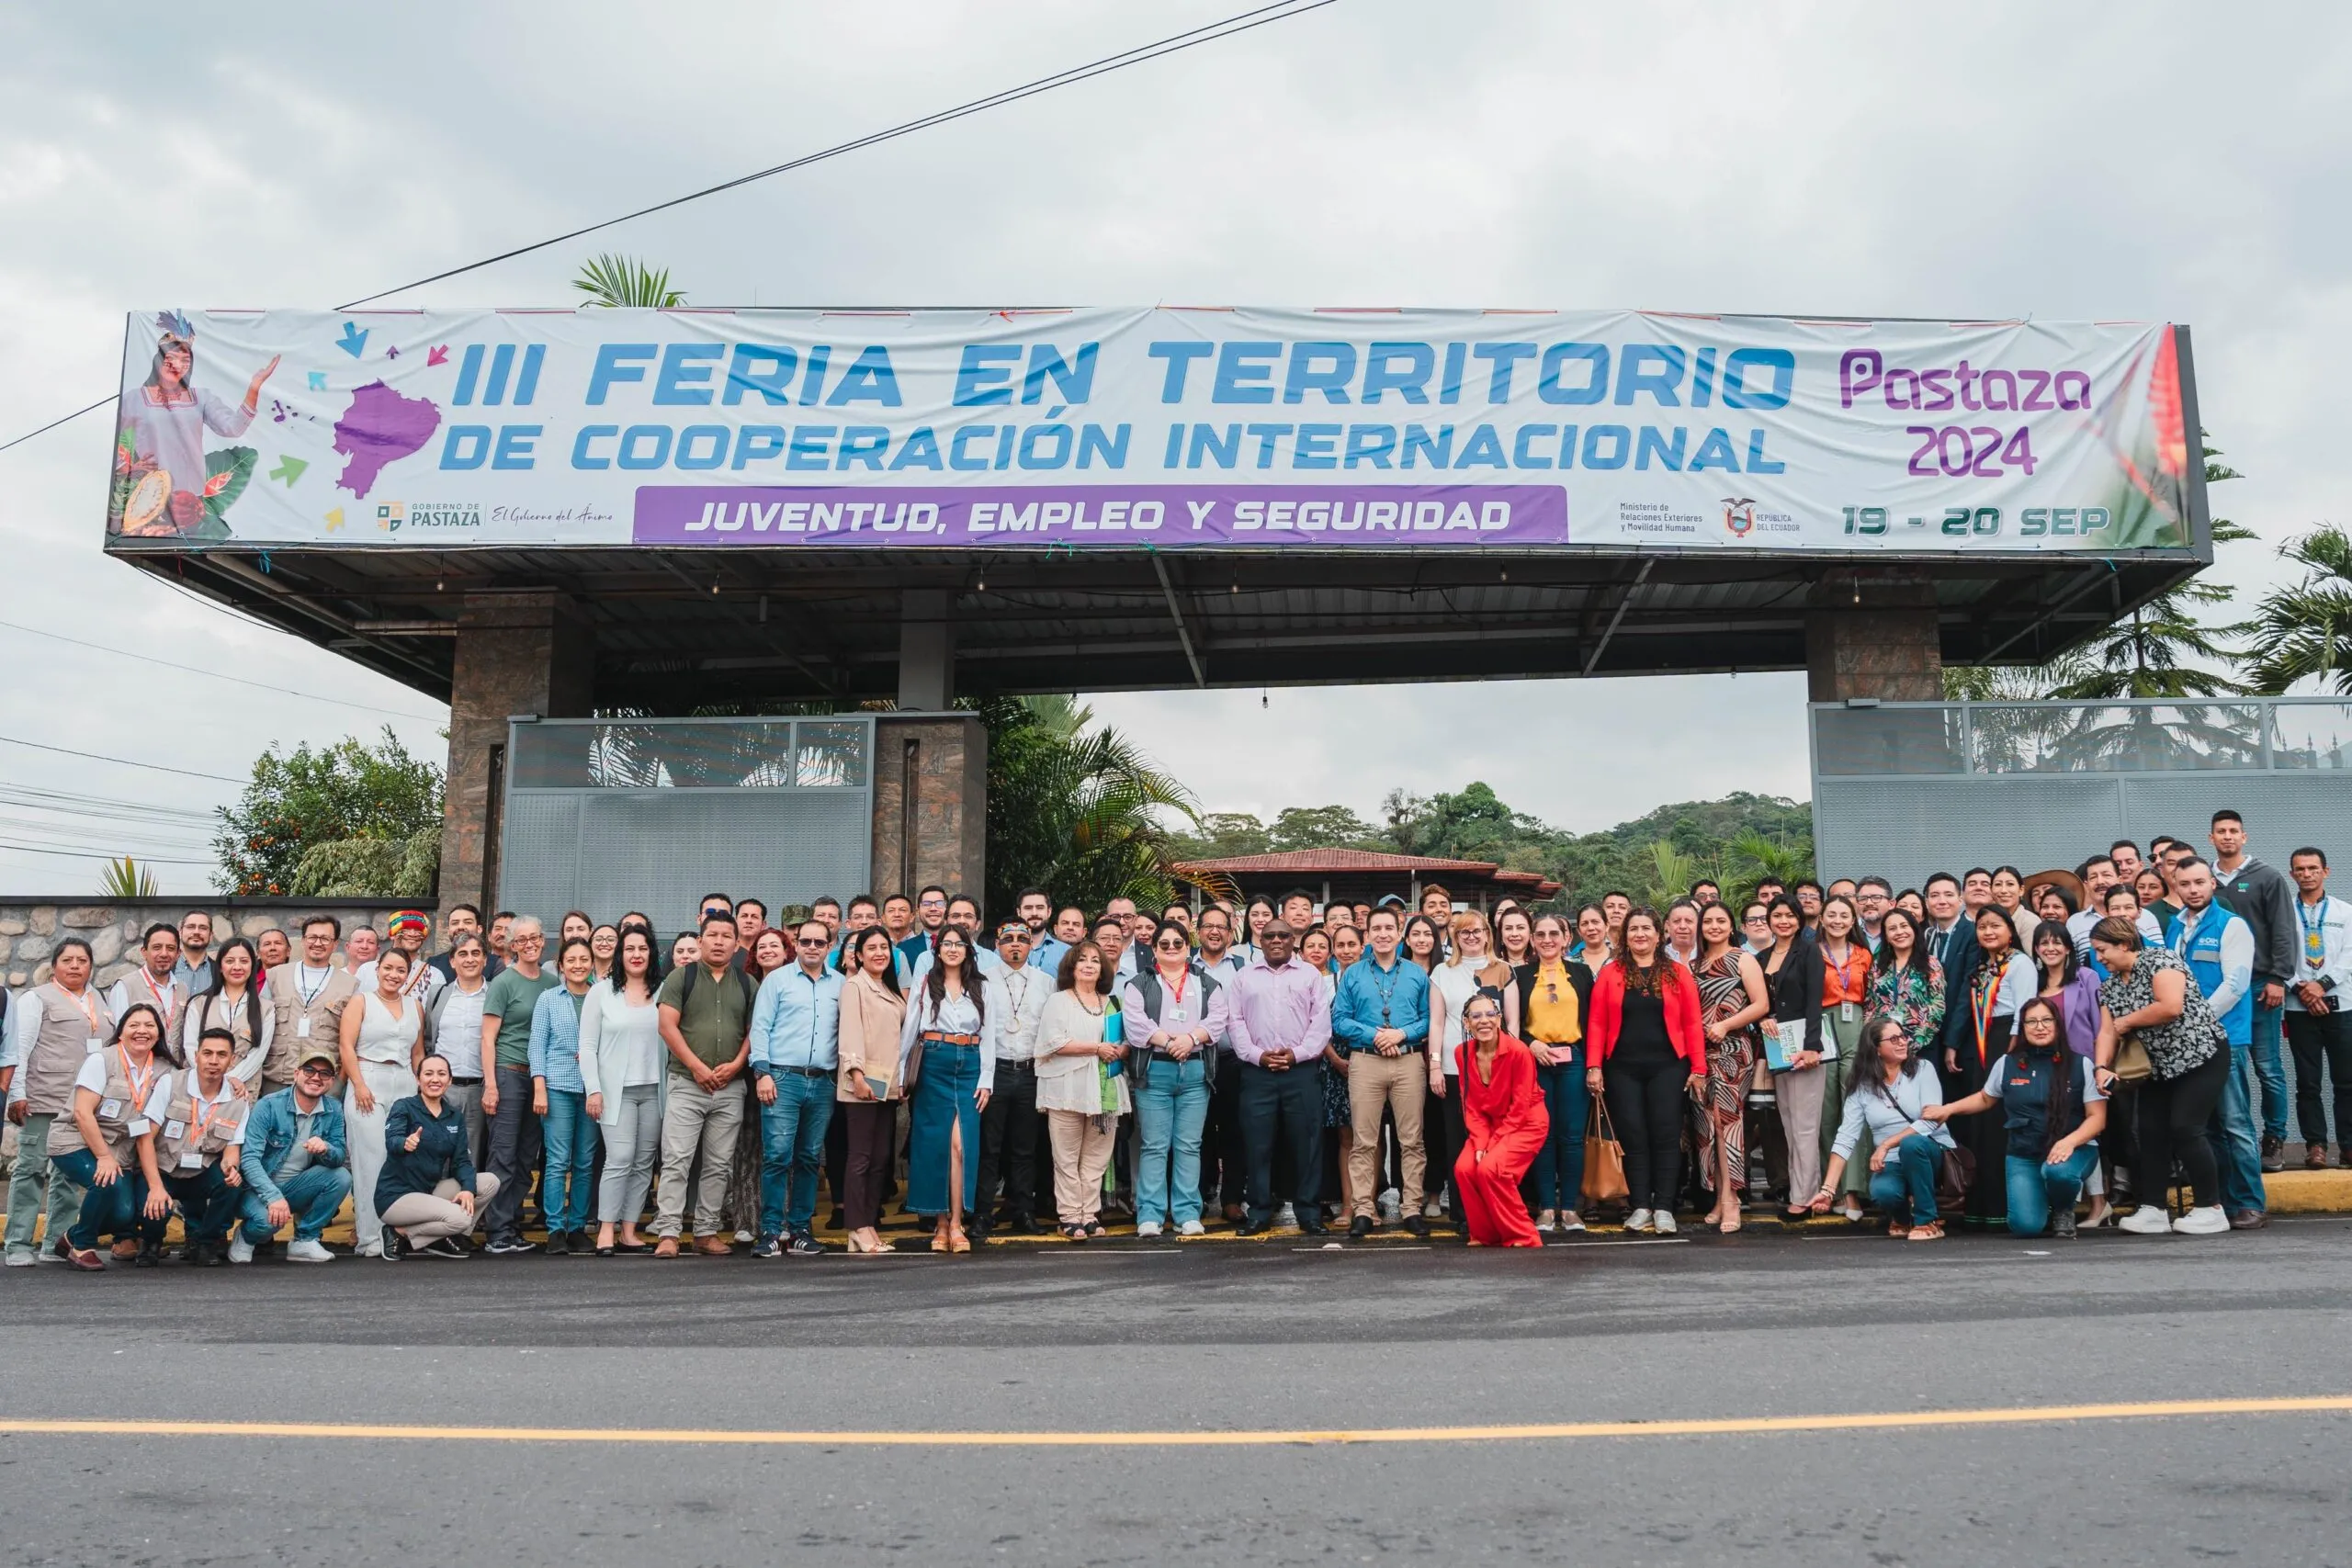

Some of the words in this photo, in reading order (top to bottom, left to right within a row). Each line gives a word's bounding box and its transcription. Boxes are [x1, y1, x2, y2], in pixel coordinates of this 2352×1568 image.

[452, 344, 547, 406] III
[585, 343, 902, 407] FERIA
[952, 341, 1101, 407] EN
[1148, 341, 1796, 411] TERRITORIO
[1839, 348, 2092, 412] Pastaza
[439, 424, 543, 470] DE
[571, 405, 1132, 471] COOPERACIÓN
[1163, 423, 1787, 475] INTERNACIONAL
[1905, 425, 2038, 478] 2024
[412, 502, 462, 511] GOBIERNO
[467, 502, 481, 511] DE
[492, 506, 508, 522] El
[555, 508, 572, 522] del
[1620, 502, 1657, 511] Ministerio
[1659, 503, 1669, 512] de
[411, 512, 481, 526] PASTAZA
[684, 502, 946, 535] JUVENTUD,
[967, 501, 1166, 532] EMPLEO
[1187, 501, 1216, 530] Y
[1232, 501, 1511, 531] SEGURIDAD
[1620, 513, 1662, 522] Relaciones
[1664, 513, 1703, 523] Exteriores
[1841, 506, 1888, 536] 19
[1939, 506, 2005, 536] 20
[2018, 506, 2111, 537] SEP
[1621, 524, 1626, 533] y
[1627, 523, 1663, 532] Movilidad
[1665, 524, 1696, 533] Humana
[1757, 523, 1770, 531] DEL
[1770, 524, 1801, 532] ECUADOR
